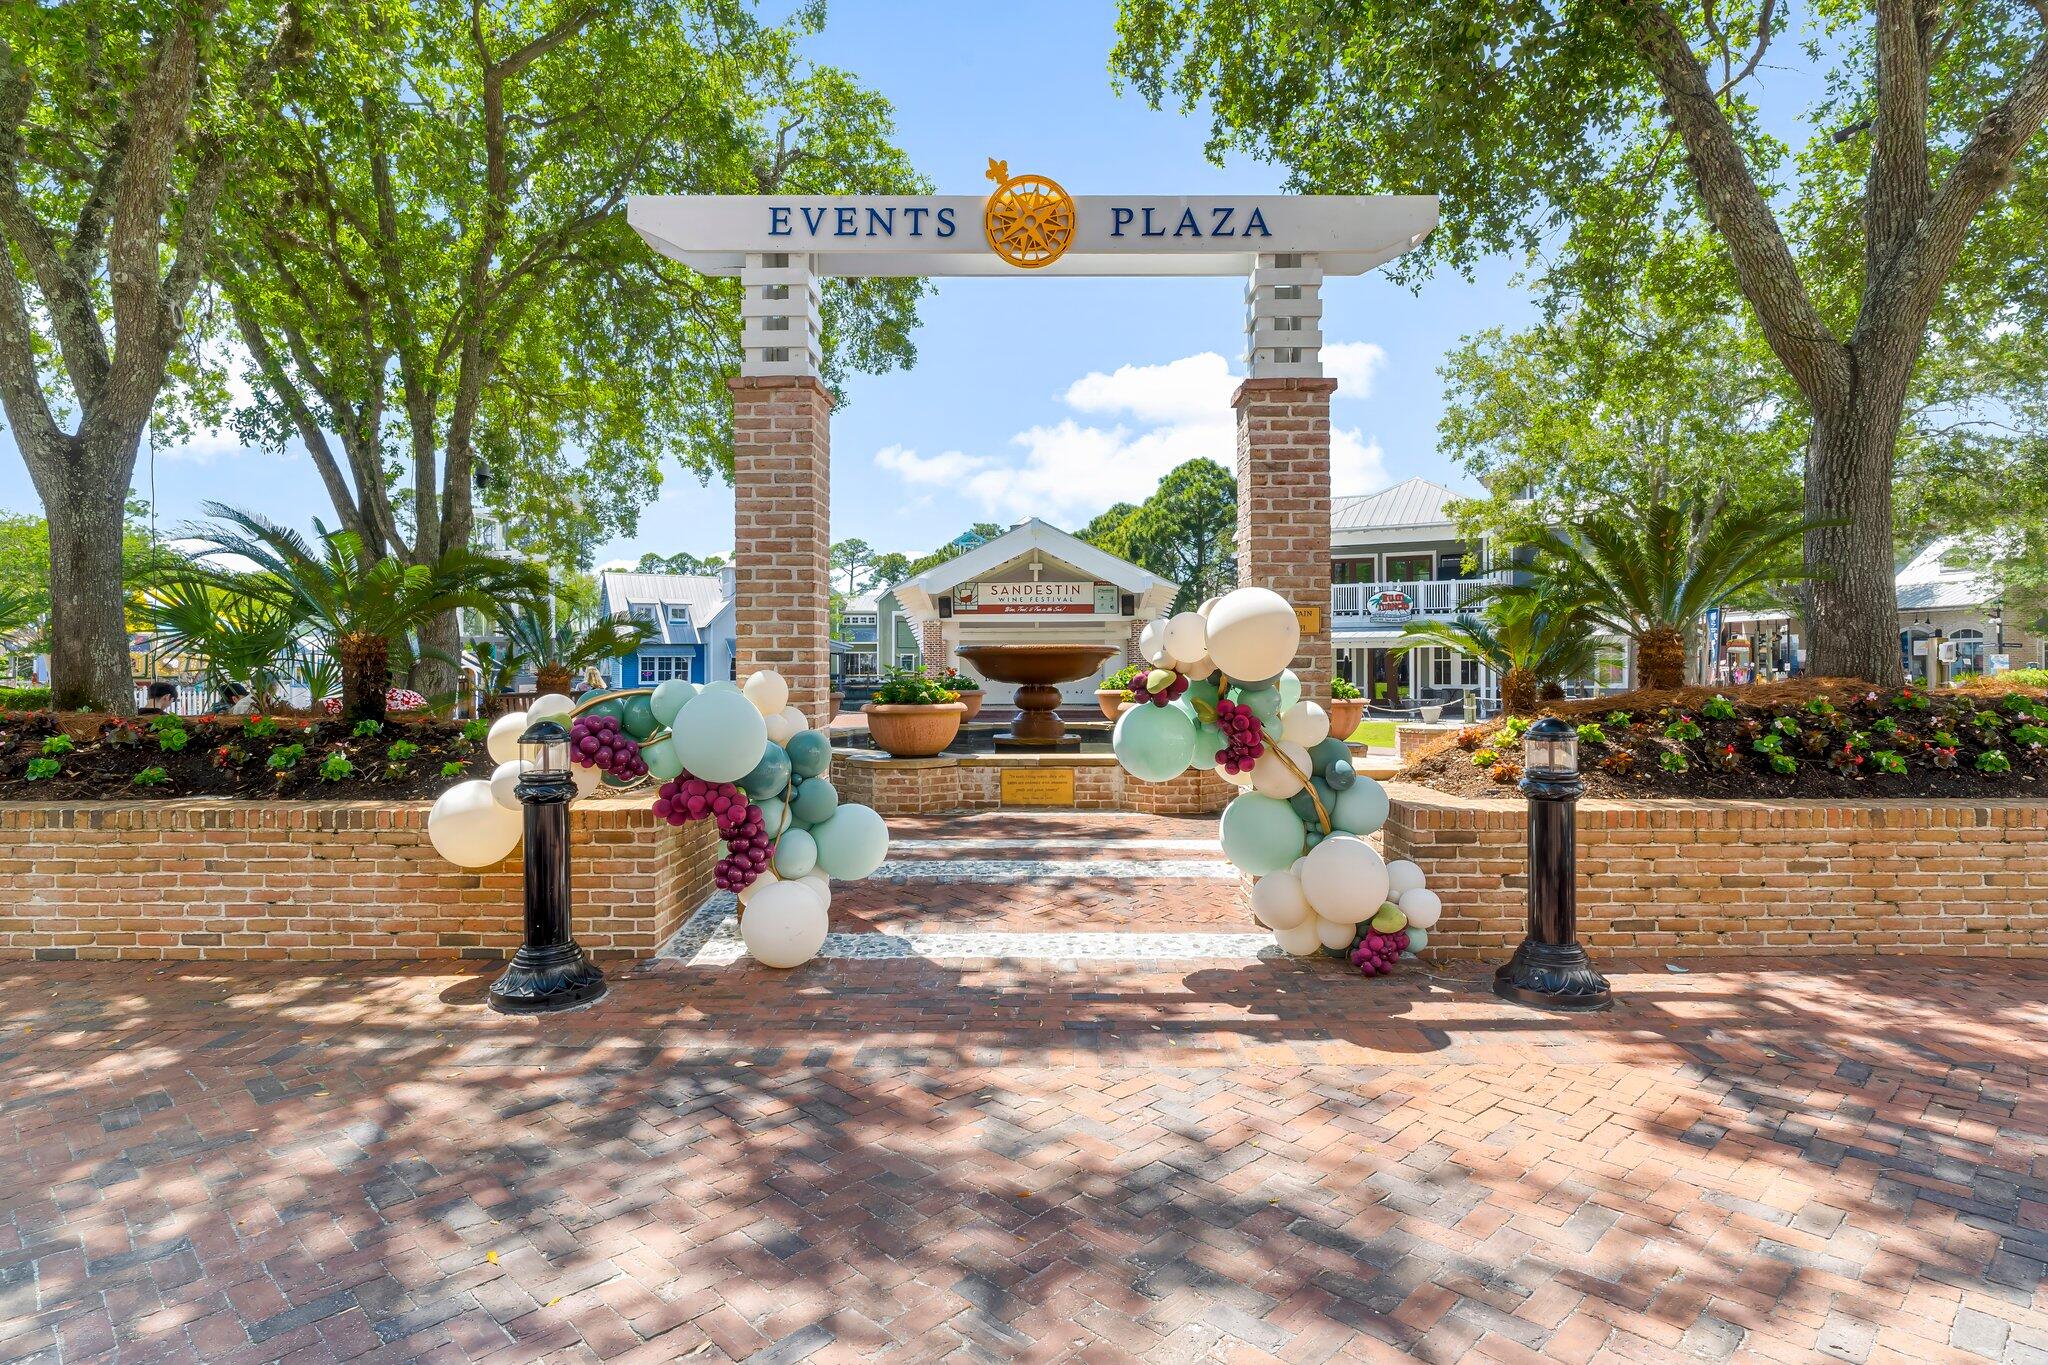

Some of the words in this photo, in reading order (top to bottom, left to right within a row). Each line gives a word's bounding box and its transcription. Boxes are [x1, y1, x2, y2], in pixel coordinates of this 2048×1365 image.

[768, 207, 957, 238] EVENTS
[1110, 207, 1273, 238] PLAZA
[991, 585, 1081, 596] SANDESTIN
